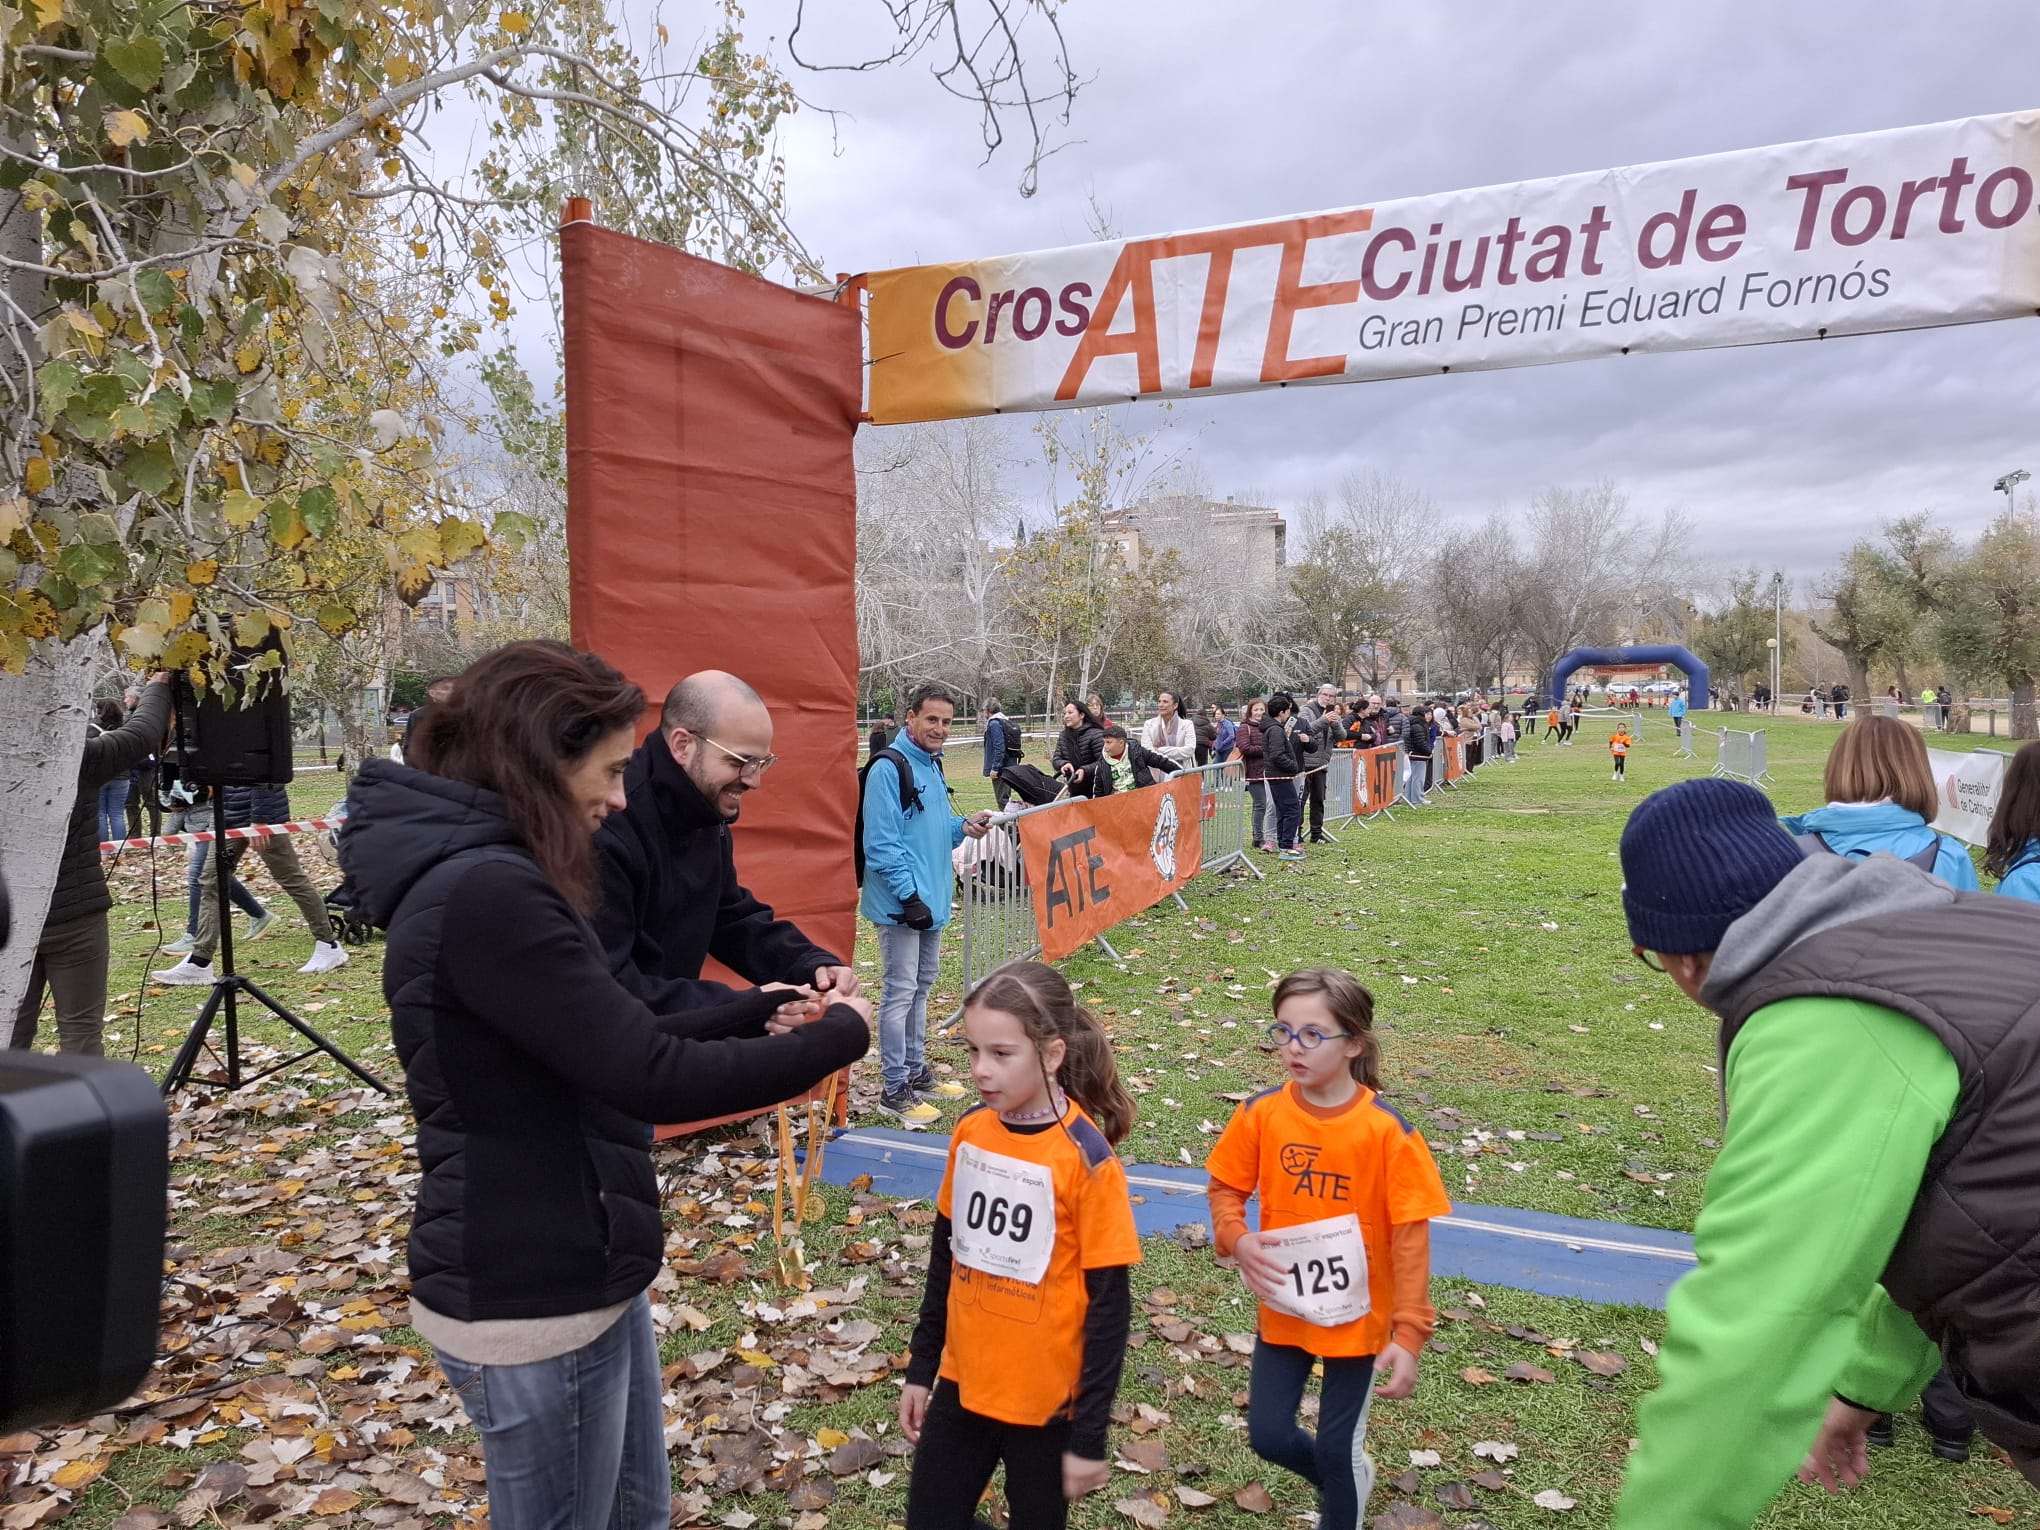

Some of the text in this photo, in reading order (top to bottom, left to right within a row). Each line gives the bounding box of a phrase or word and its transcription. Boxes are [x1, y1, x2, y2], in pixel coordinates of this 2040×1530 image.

[935, 156, 2040, 401] Cros ATE Ciutat de Torto
[1359, 260, 1891, 350] Gran Premi Eduard Fornós
[1046, 825, 1111, 930] ATE
[966, 1190, 1033, 1243] 069
[1293, 1169, 1351, 1202] ATE
[1287, 1254, 1350, 1297] 125
